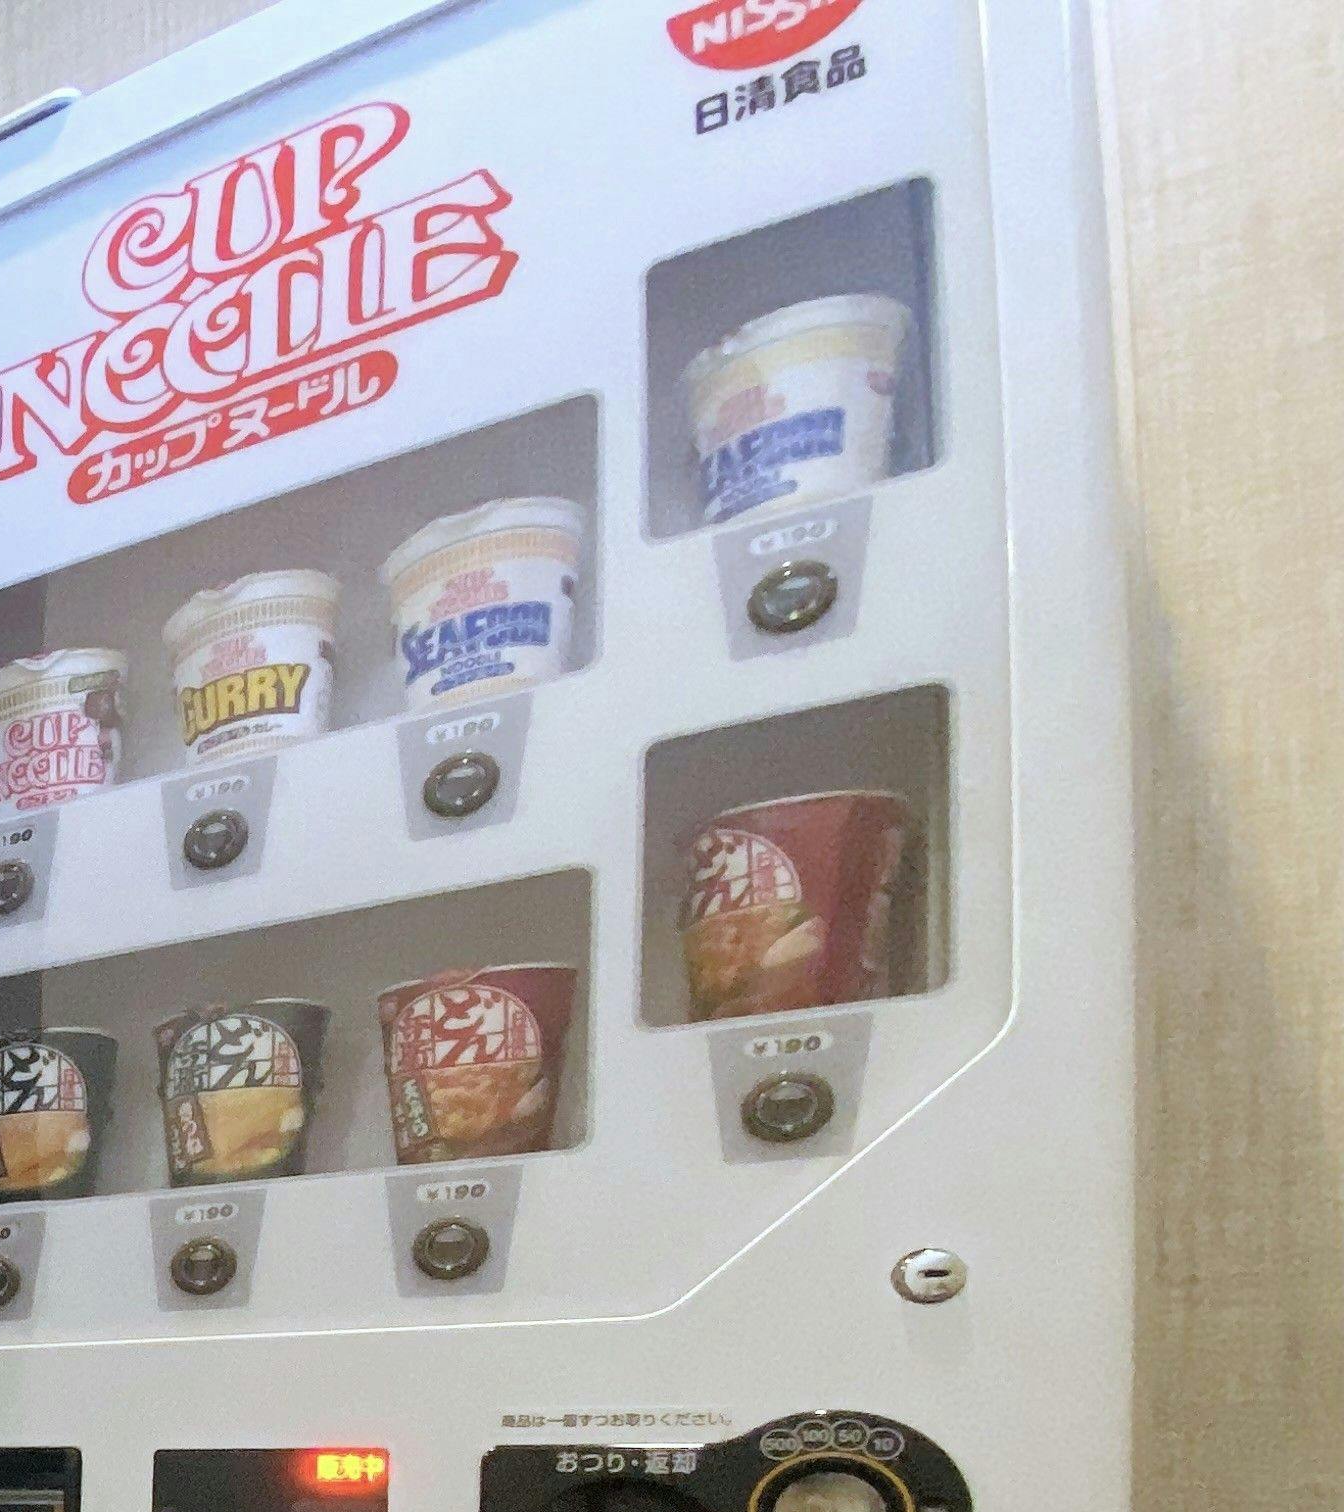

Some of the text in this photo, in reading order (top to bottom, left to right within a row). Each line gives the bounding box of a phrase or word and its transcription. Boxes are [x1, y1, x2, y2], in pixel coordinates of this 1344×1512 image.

[692, 0, 839, 54] NISS
[696, 44, 868, 135] 日清食品
[82, 102, 411, 318] CUP
[87, 363, 380, 499] カップヌードル
[179, 662, 310, 746] CURRY
